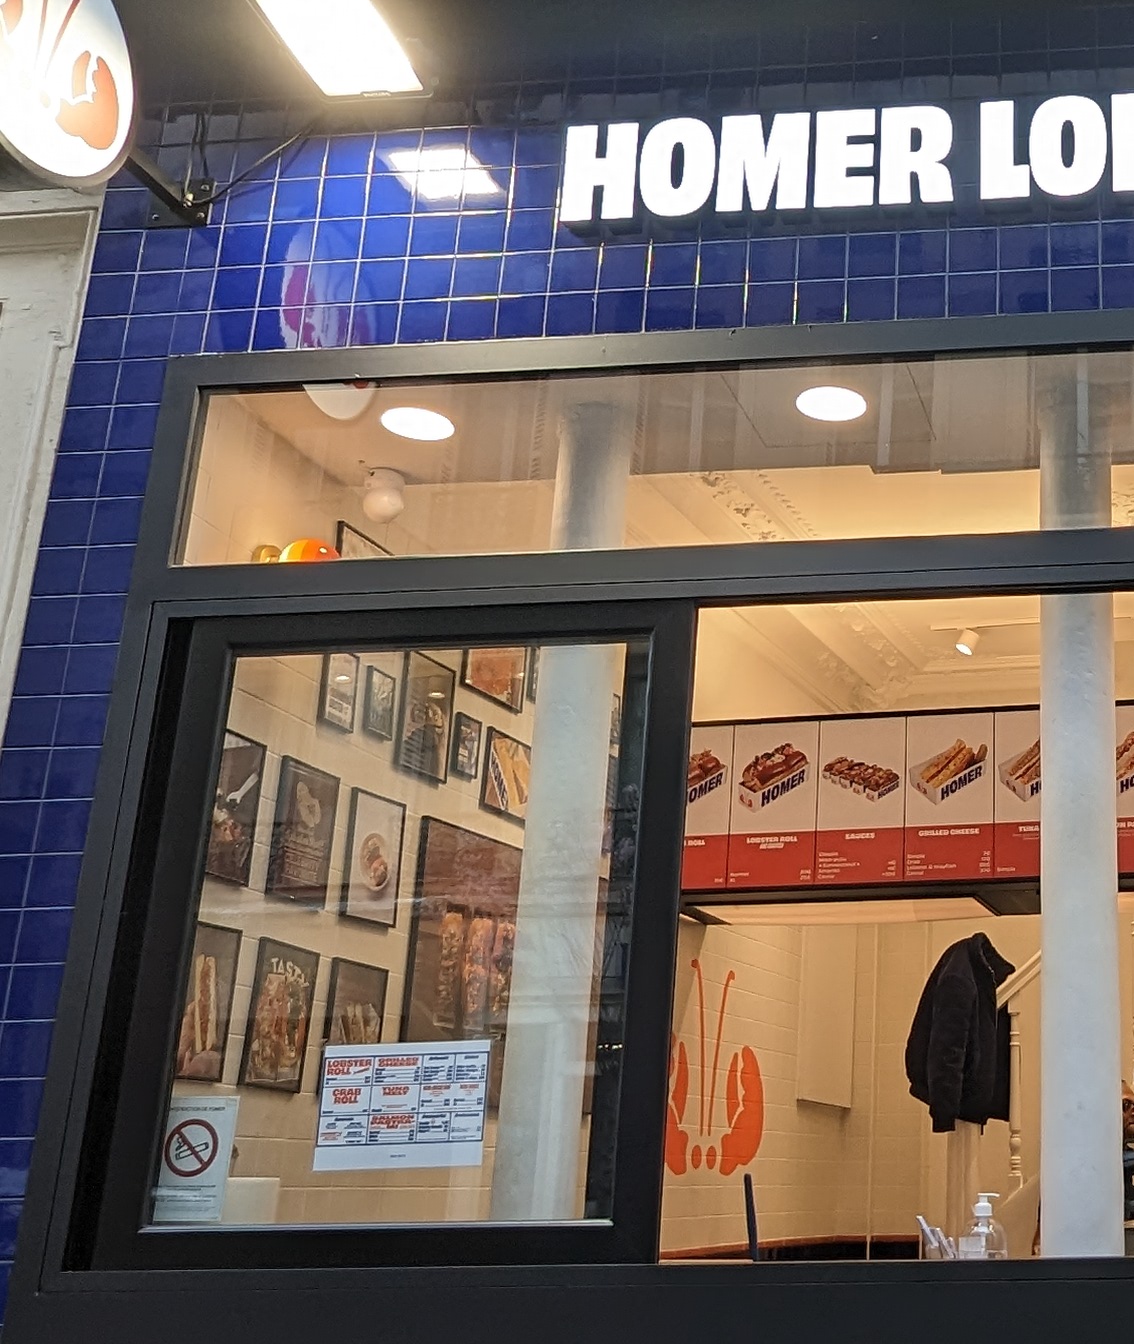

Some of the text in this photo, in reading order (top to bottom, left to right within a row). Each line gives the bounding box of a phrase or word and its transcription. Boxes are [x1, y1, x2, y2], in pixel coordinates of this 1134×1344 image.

[558, 104, 955, 223] HOMER
[687, 771, 725, 805] OMER
[760, 768, 807, 807] HOMER
[940, 765, 984, 801] HOMER
[918, 827, 980, 837] GRILLED CHEESE
[746, 835, 798, 844] LOBSTER ROLL
[326, 1059, 373, 1068] LOBSTER
[326, 1067, 352, 1076] ROLL
[332, 1087, 362, 1097] CRAB
[333, 1095, 359, 1105] ROLL
